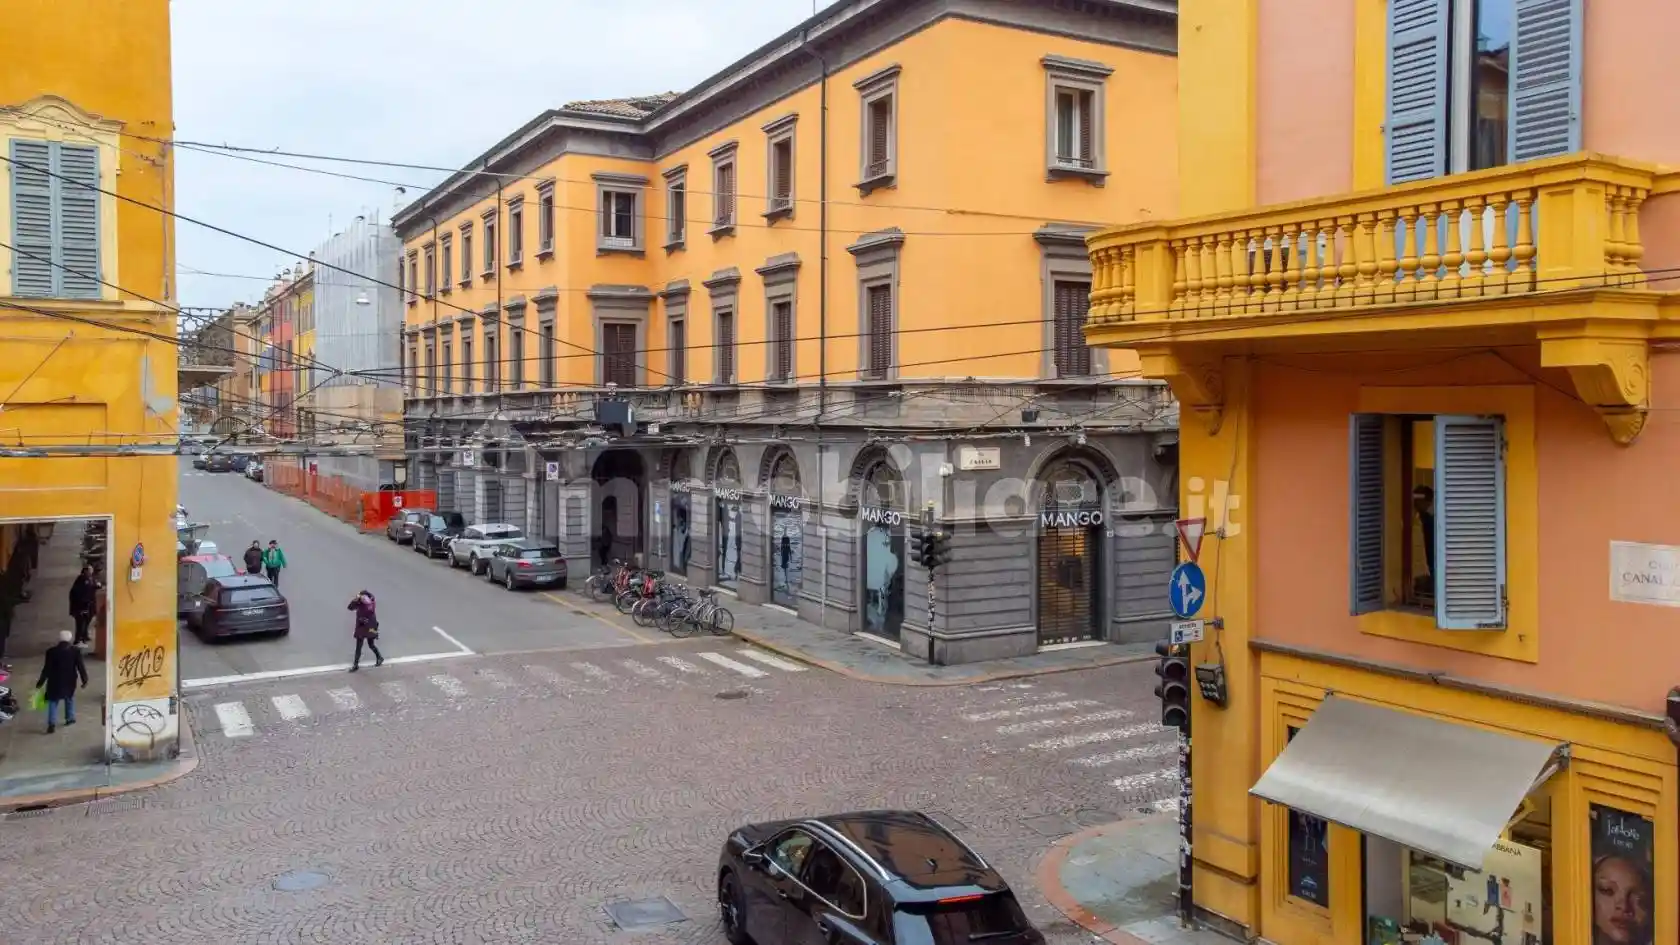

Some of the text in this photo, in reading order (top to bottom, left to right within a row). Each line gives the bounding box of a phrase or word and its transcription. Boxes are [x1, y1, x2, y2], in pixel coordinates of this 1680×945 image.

[669, 481, 690, 493] MANGO
[715, 487, 740, 500] MANGO
[769, 494, 800, 509] MANGO
[862, 506, 901, 526] MANGO
[1040, 510, 1103, 527] MANGO
